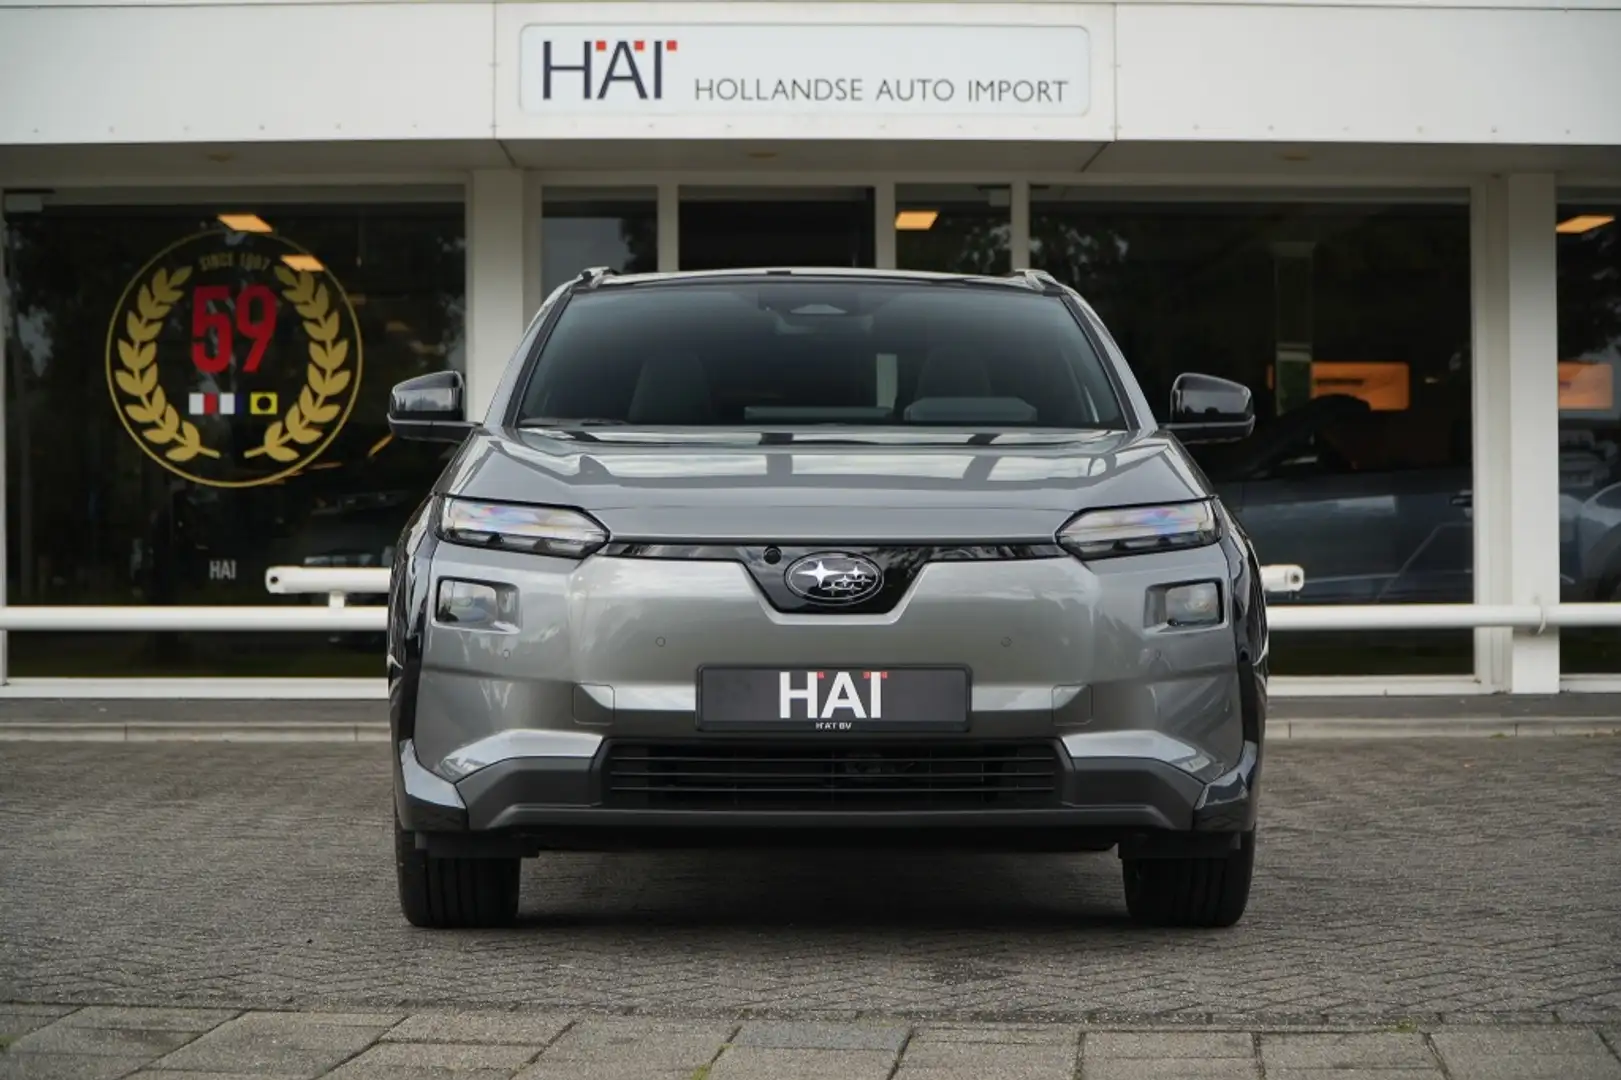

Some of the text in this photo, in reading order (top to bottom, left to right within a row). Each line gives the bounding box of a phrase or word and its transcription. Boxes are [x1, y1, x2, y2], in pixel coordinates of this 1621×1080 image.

[695, 78, 1069, 103] HOLLANDSE AUTO IMPORT
[192, 284, 278, 374] 59
